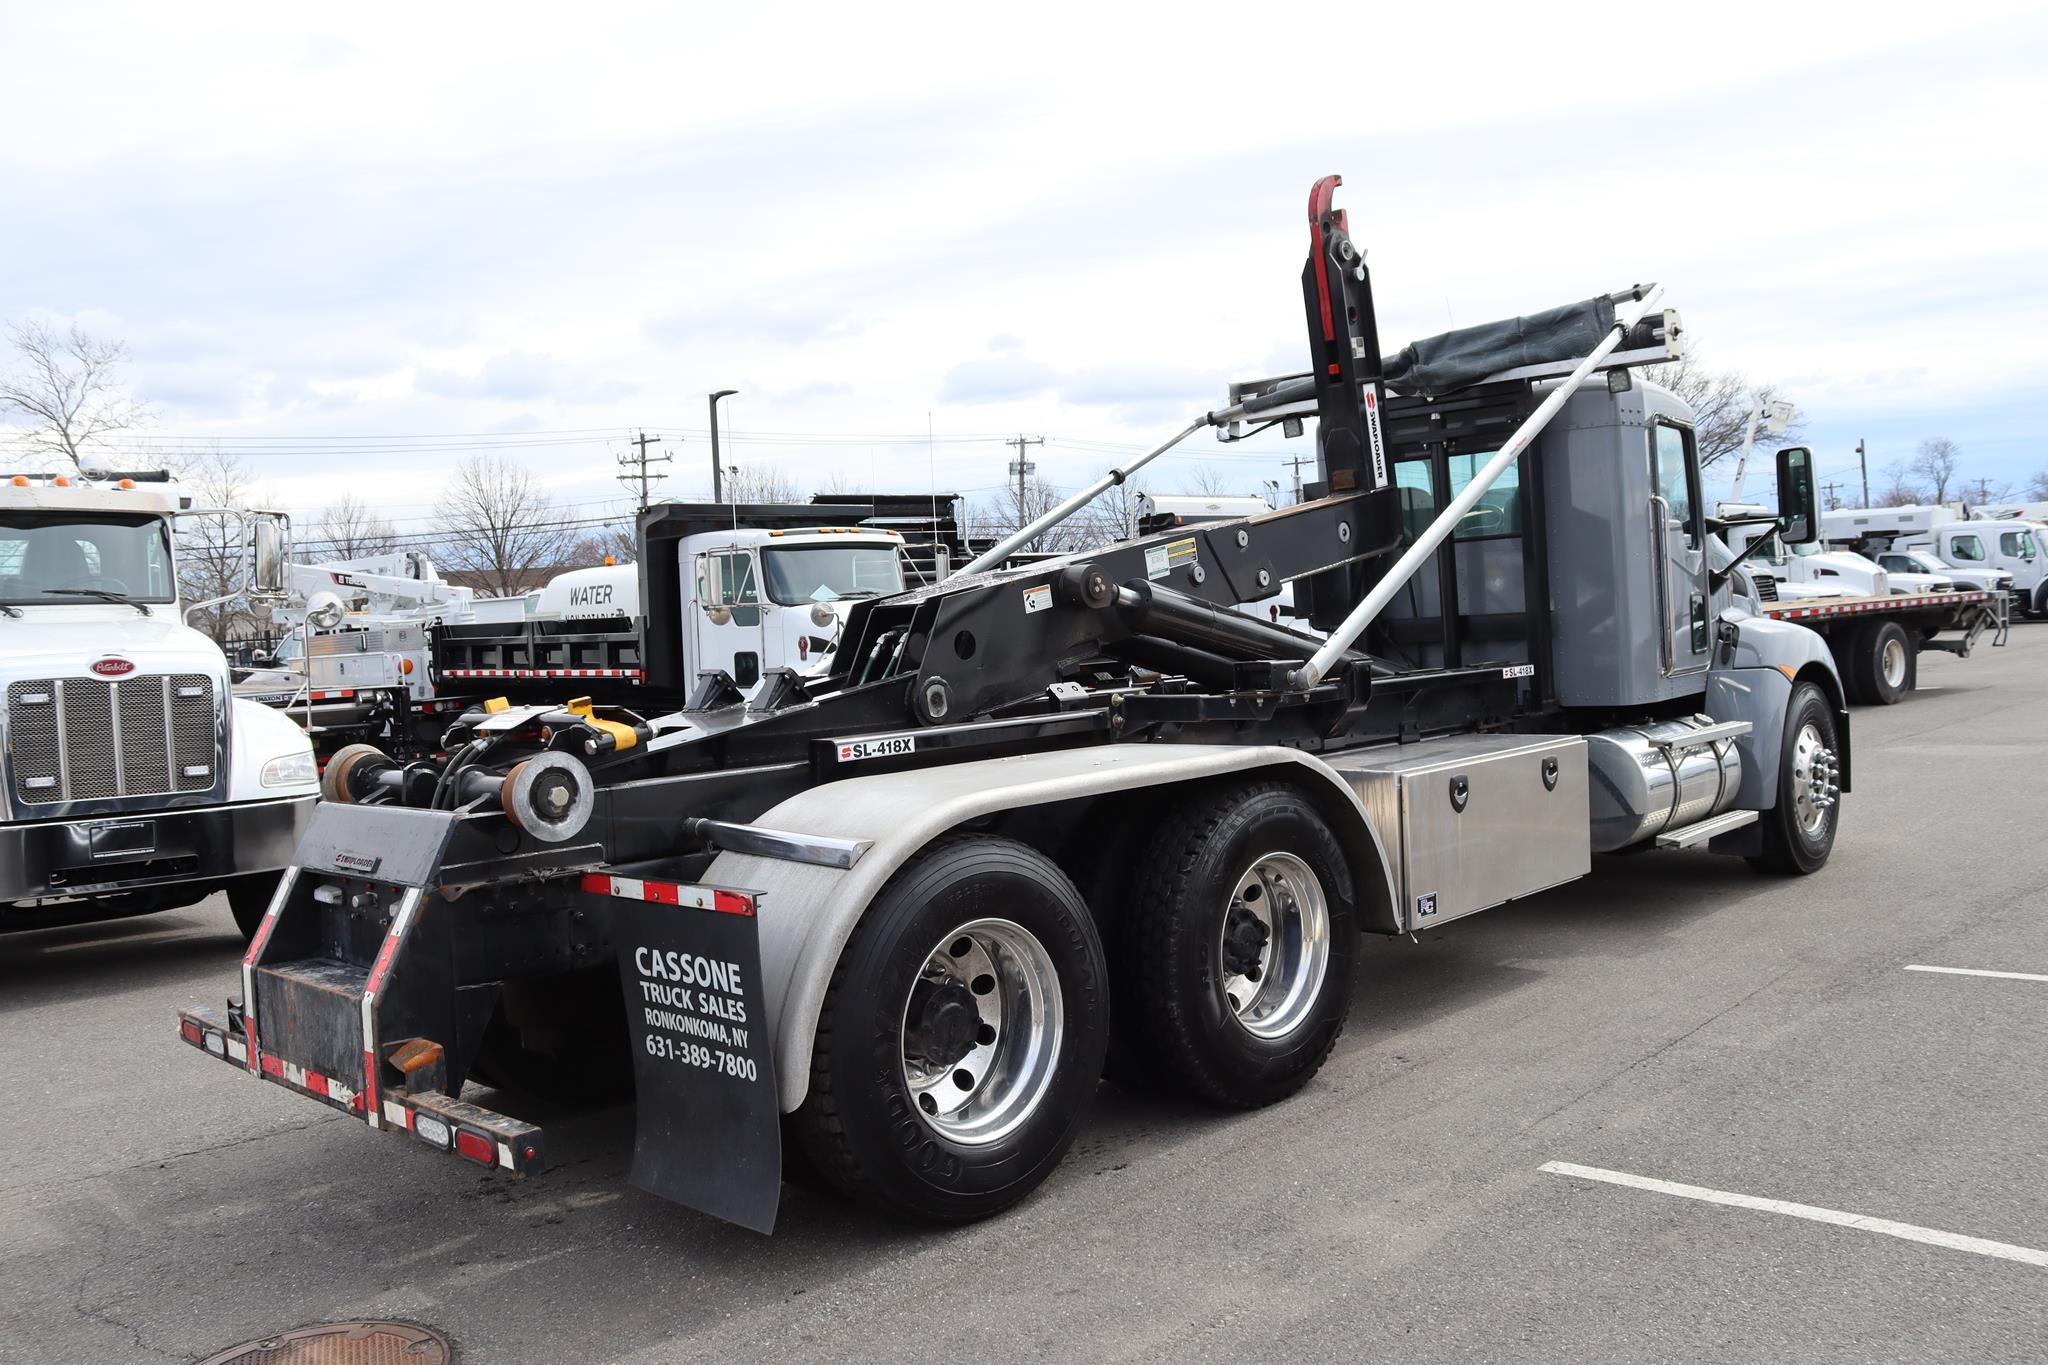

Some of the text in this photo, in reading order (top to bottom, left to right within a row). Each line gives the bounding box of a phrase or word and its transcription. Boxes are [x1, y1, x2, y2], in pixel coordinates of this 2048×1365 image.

[1369, 411, 1384, 479] SWAPLOADER
[570, 584, 613, 606] WATER
[853, 739, 911, 758] SL-418X
[635, 946, 744, 995] CASSONE
[639, 981, 747, 1023] TRUCK SALES
[645, 1007, 731, 1047] RONKONKOMA,
[646, 1034, 757, 1082] 631-389-7800
